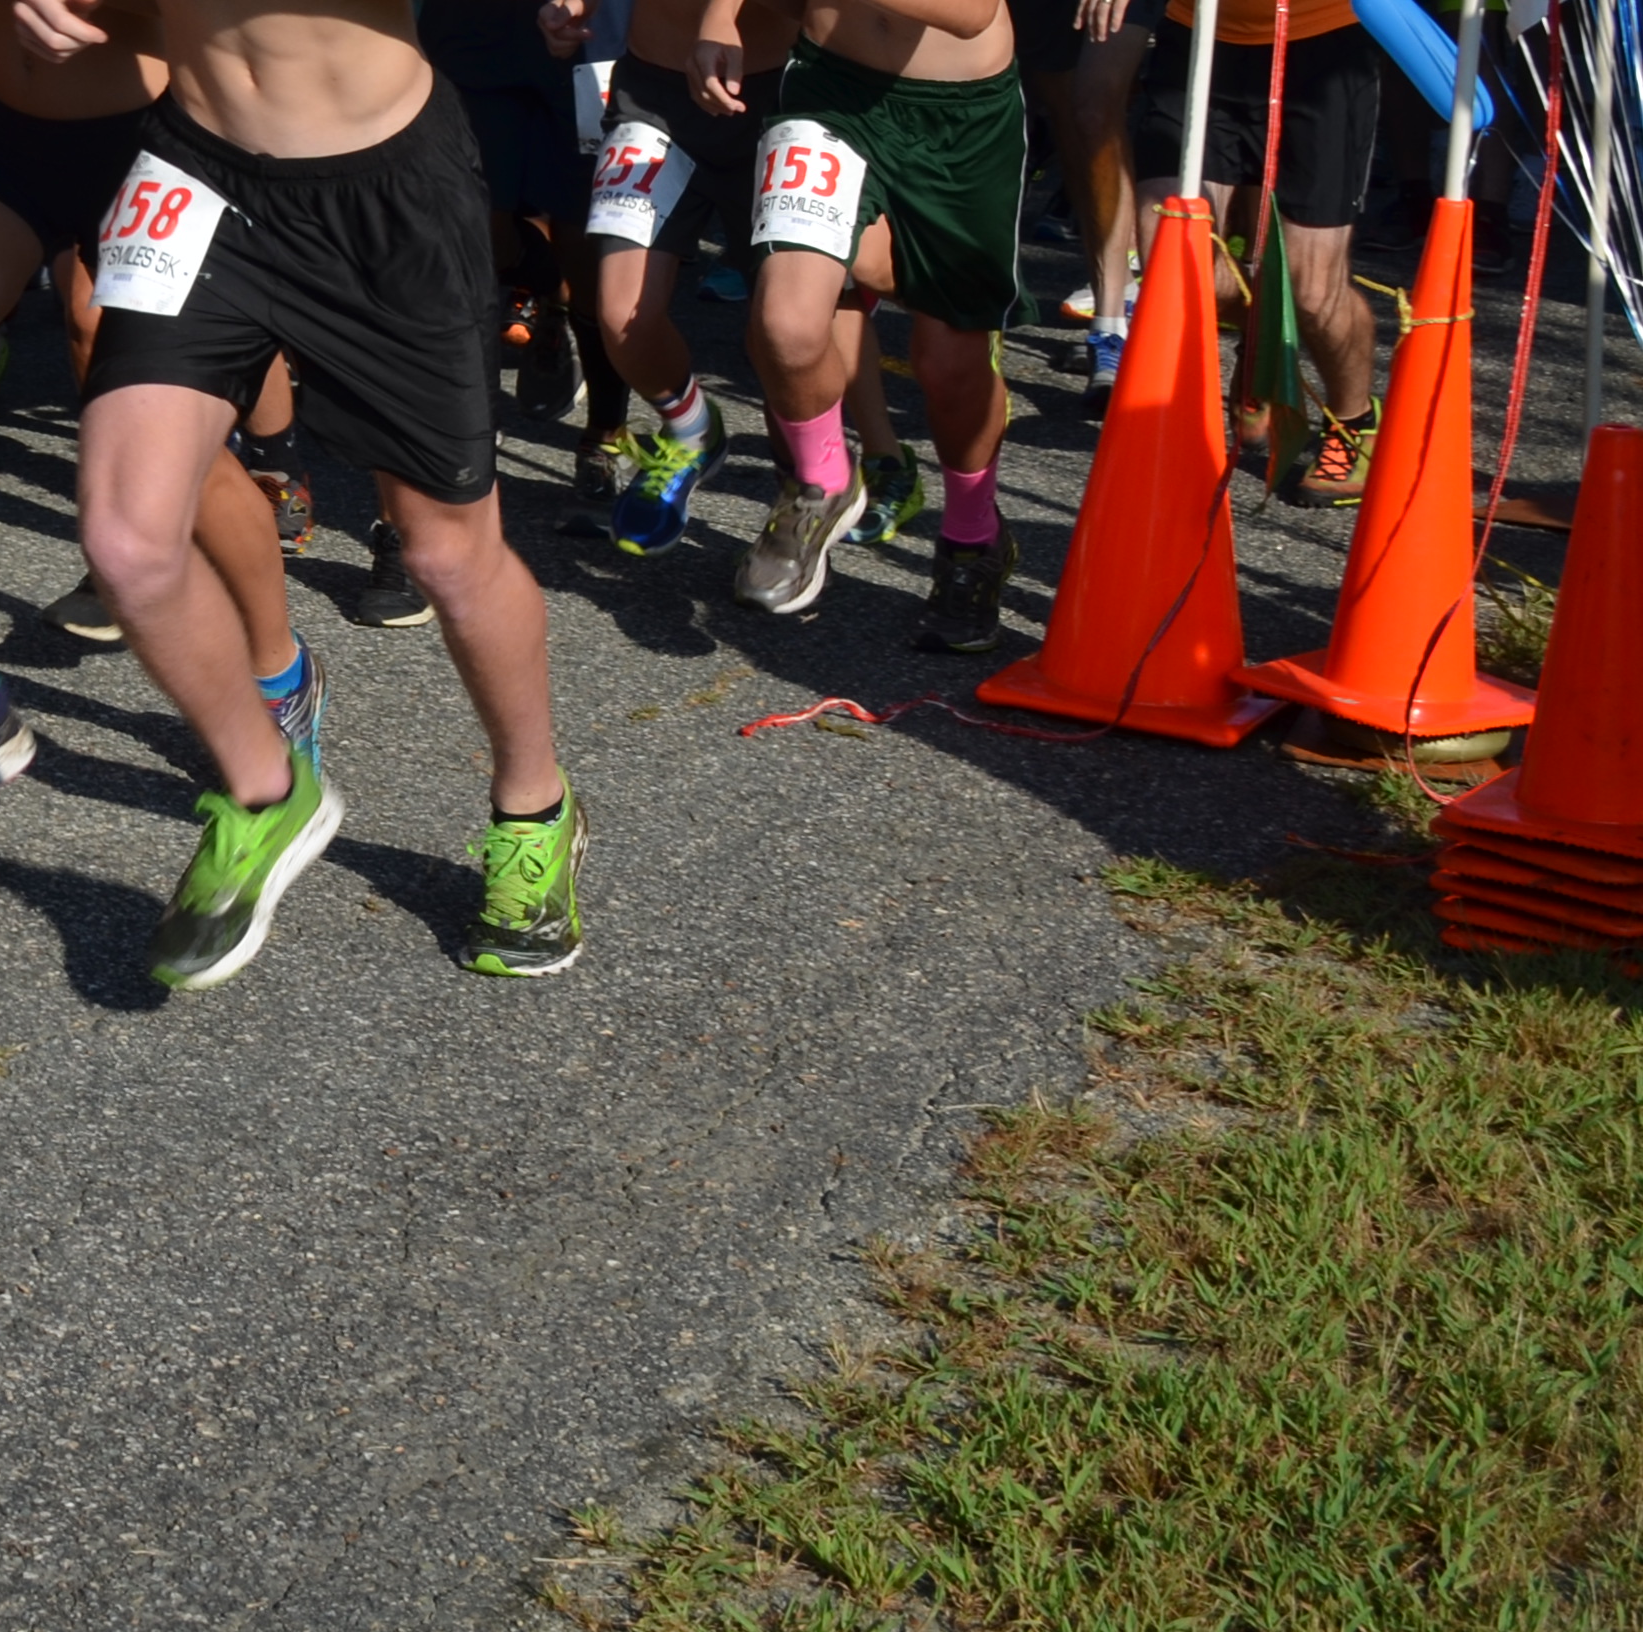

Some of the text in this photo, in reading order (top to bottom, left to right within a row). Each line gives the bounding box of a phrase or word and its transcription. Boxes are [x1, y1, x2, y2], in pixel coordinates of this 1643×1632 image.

[593, 145, 666, 195] 251
[759, 145, 842, 198] 153
[100, 180, 193, 243] 158
[778, 194, 826, 219] SMILES
[826, 206, 844, 227] 5K
[107, 244, 156, 269] SMILES
[155, 252, 182, 279] 5K
